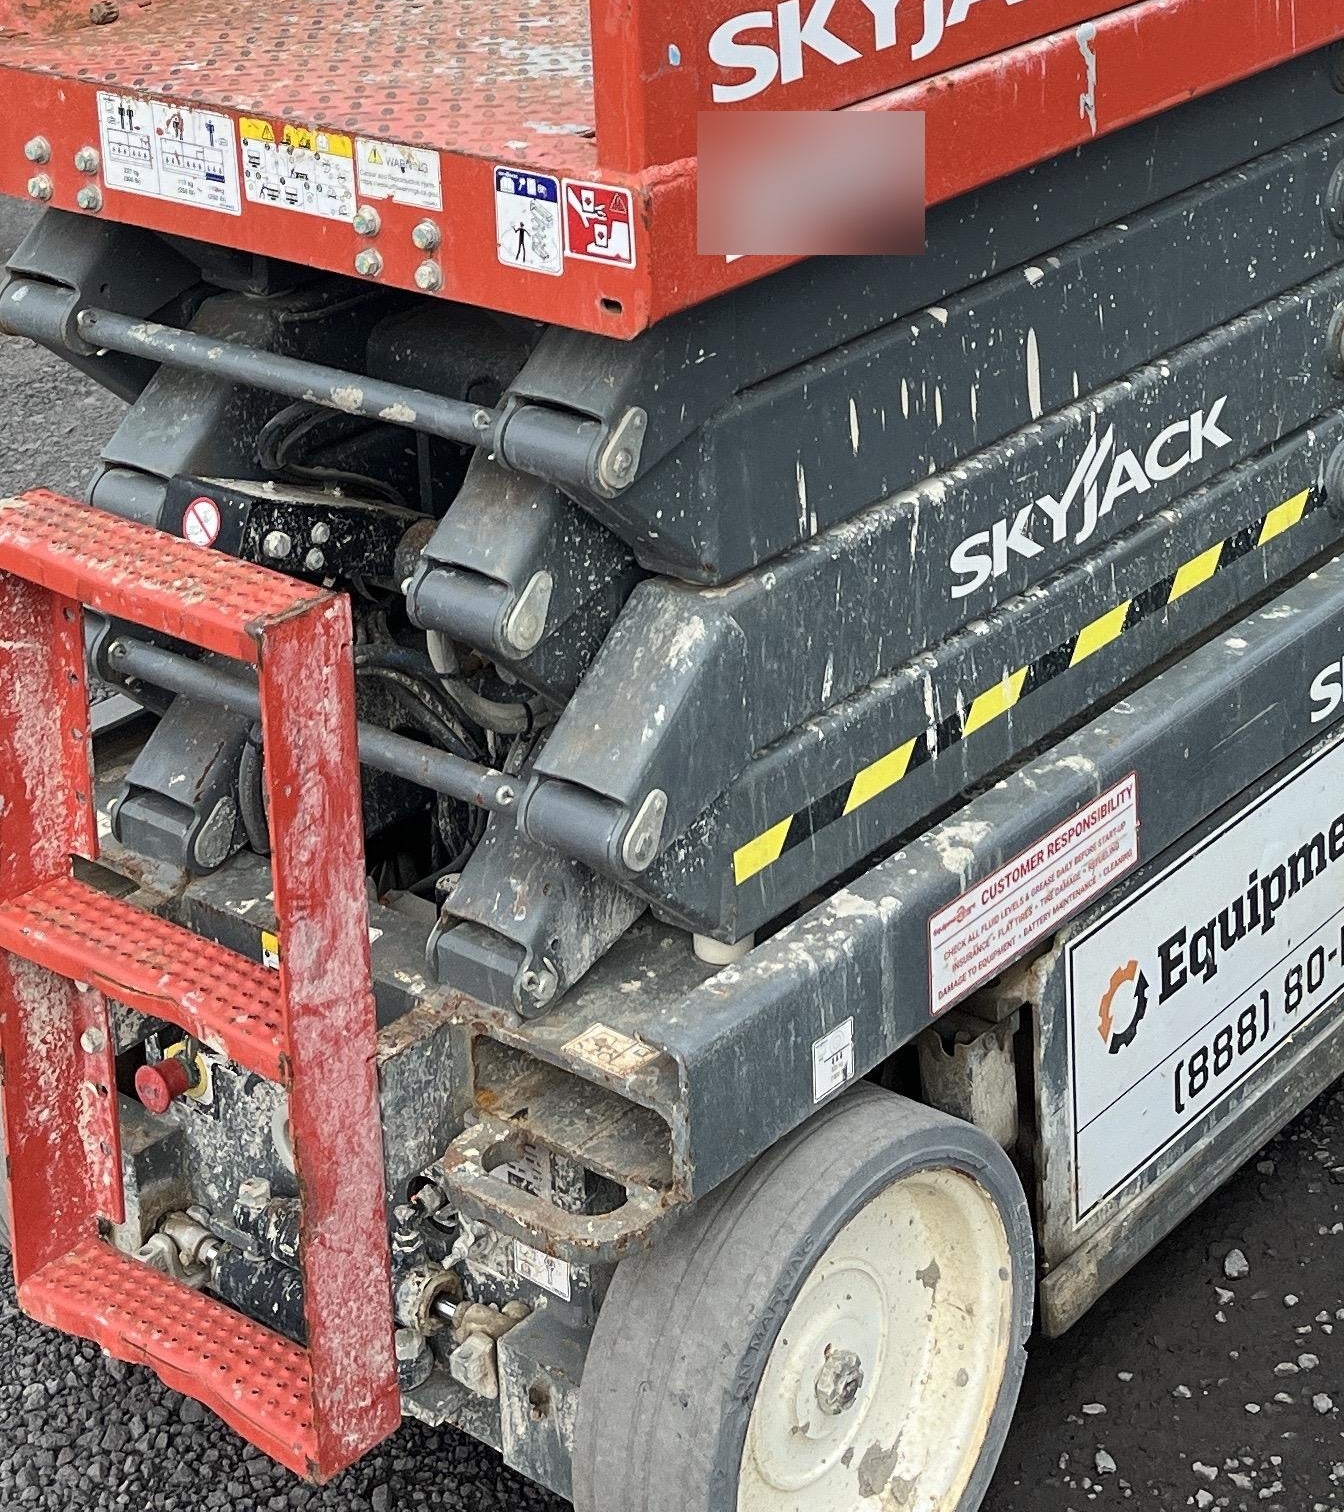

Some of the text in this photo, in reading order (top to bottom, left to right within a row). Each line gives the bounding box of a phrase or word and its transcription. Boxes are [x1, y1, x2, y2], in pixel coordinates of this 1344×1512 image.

[950, 395, 1233, 599] SKYJACK
[981, 784, 1133, 906] CUSTOMER RESPONSIBILITY
[1174, 990, 1269, 1115] (888)
